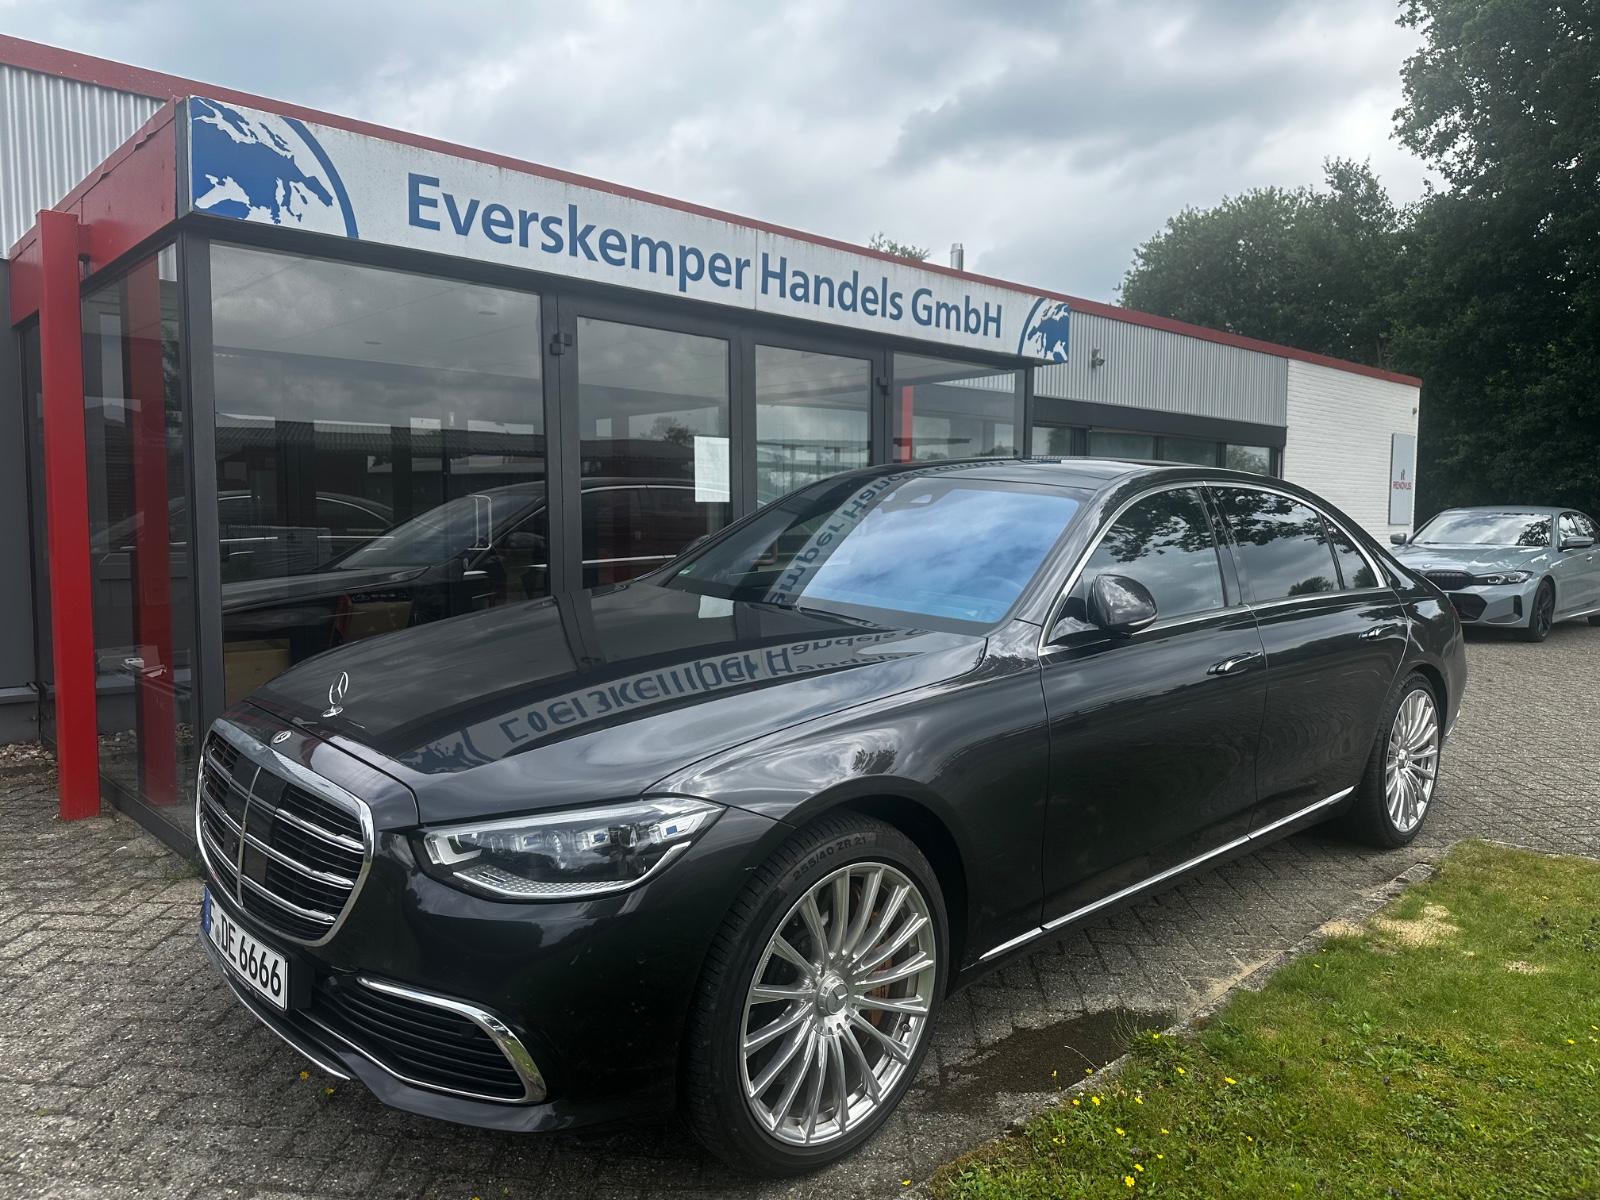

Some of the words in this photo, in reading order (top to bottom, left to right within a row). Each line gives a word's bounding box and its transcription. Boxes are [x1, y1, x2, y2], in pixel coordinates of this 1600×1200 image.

[408, 172, 752, 292] Everskemper
[760, 252, 904, 322] Handels
[911, 288, 1003, 339] GmbH
[792, 846, 834, 881] 255/40
[836, 838, 852, 850] ZR
[854, 835, 867, 846] 21
[221, 914, 237, 964] DE
[240, 935, 282, 997] 6666
